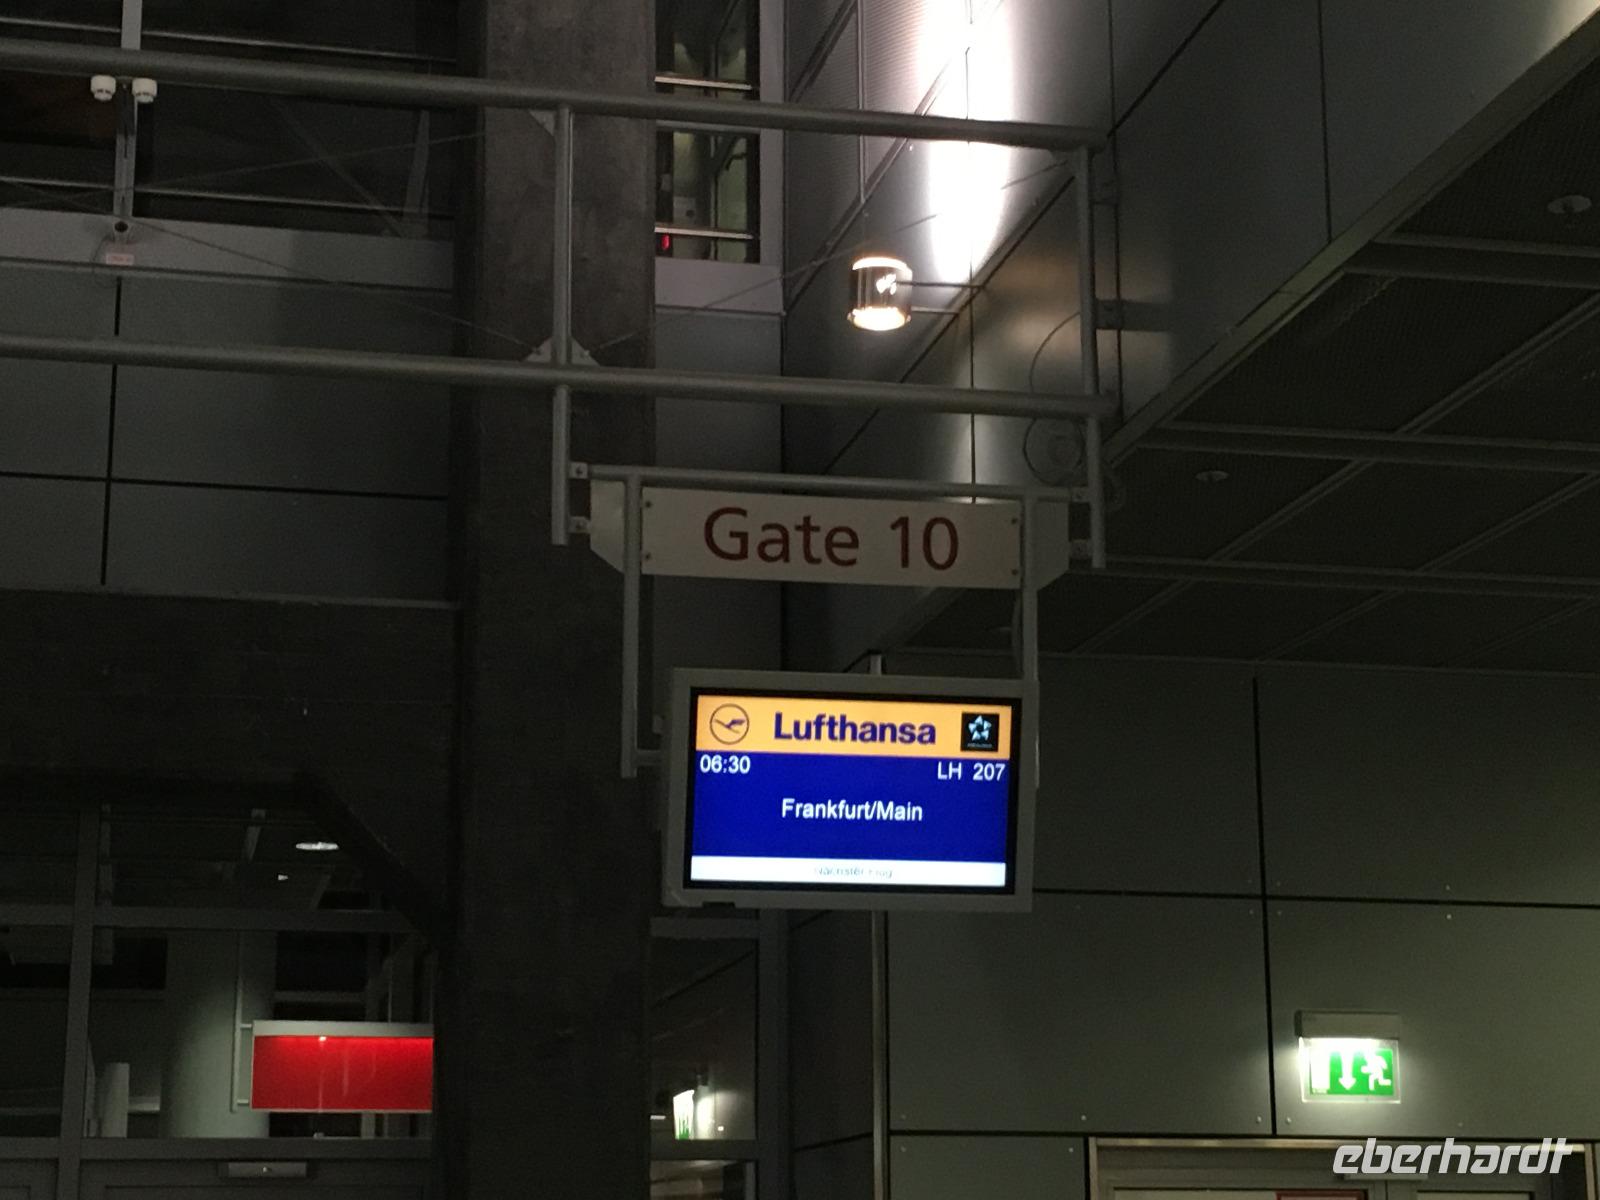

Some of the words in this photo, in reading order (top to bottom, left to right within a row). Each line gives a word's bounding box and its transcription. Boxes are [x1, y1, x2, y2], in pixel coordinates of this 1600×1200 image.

[703, 506, 860, 567] Gate
[889, 516, 960, 571] 10
[773, 710, 936, 745] Lufthansa
[699, 754, 751, 775] 06:30
[937, 761, 962, 781] LH
[972, 762, 1006, 782] 207
[781, 797, 923, 821] Frankfurt/Main
